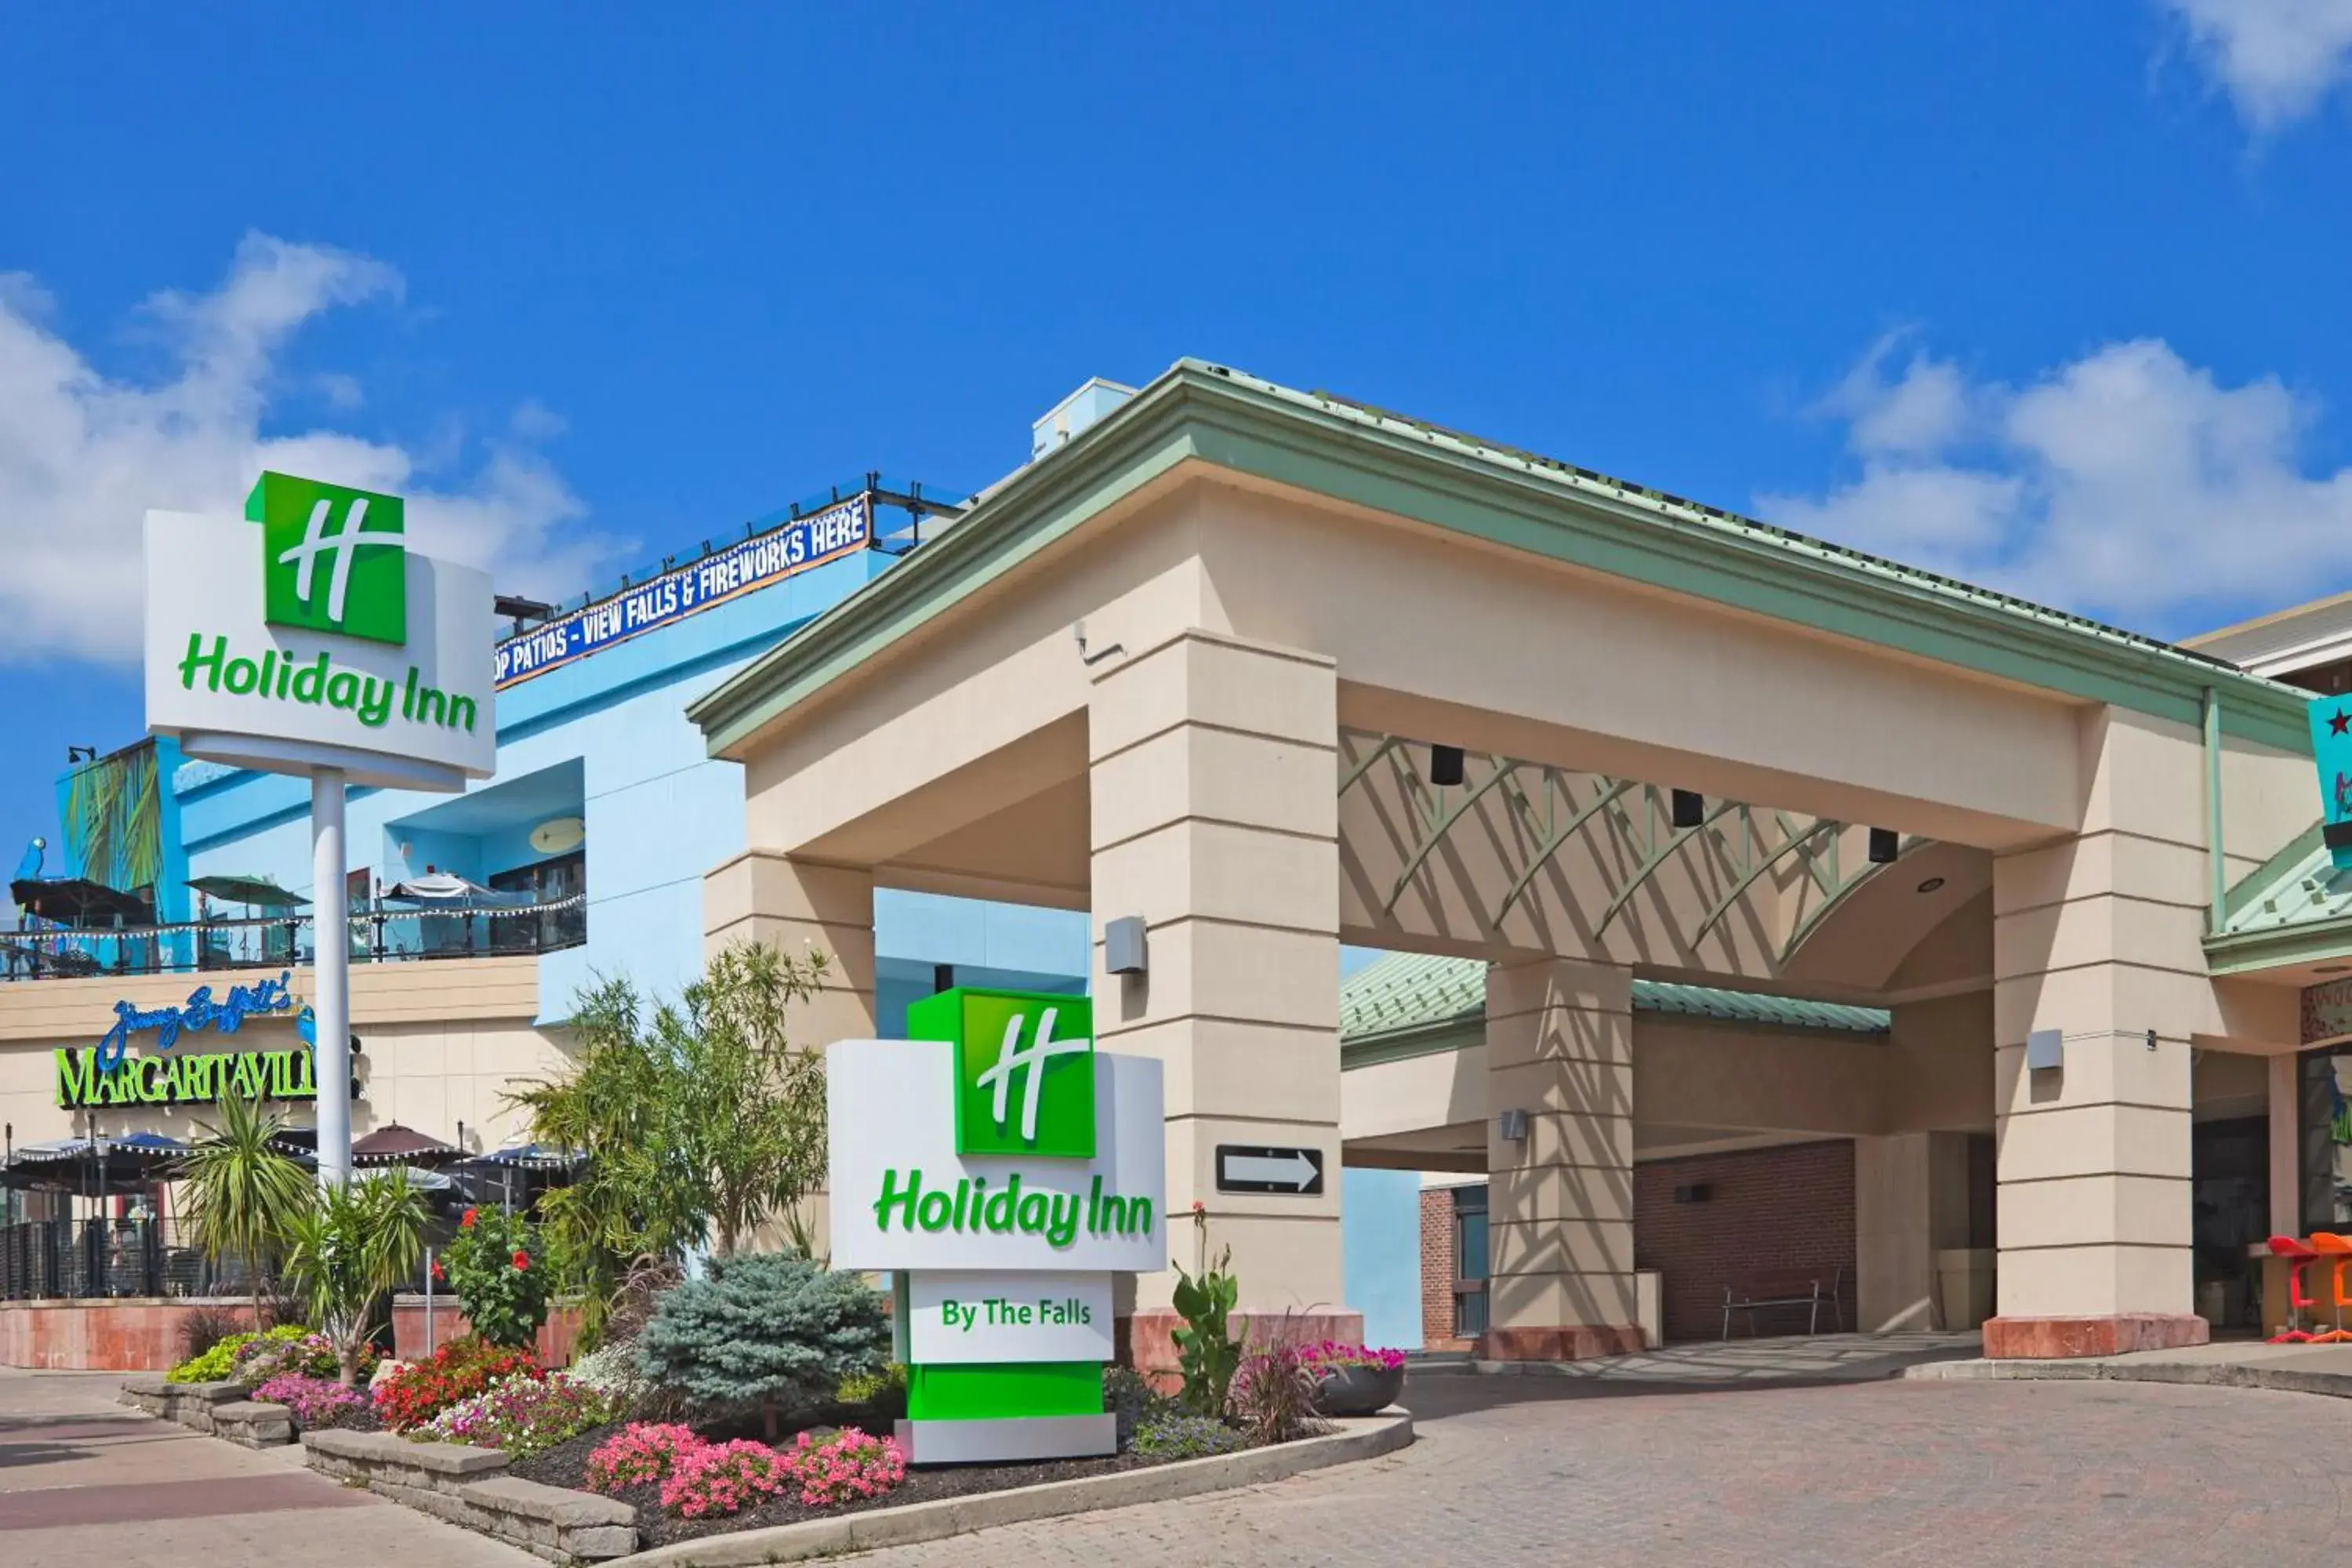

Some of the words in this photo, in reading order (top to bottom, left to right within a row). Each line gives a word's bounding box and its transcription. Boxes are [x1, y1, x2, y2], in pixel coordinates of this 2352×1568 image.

[278, 498, 404, 622] H
[513, 626, 567, 673] PATIOS
[583, 601, 622, 645] VIEW
[627, 583, 677, 628] FALLS
[682, 577, 695, 607] &
[700, 528, 804, 601] FIREWORKS
[811, 503, 863, 557] HERE
[177, 632, 394, 728] Holiday
[402, 666, 477, 732] Inn
[53, 1047, 317, 1105] MARGARITAVILL
[977, 1007, 1091, 1140] H
[873, 1168, 1080, 1248] Holiday
[1087, 1174, 1152, 1235] Inn
[941, 1299, 976, 1332] By
[982, 1299, 1032, 1326] The
[1039, 1298, 1091, 1326] Falls
